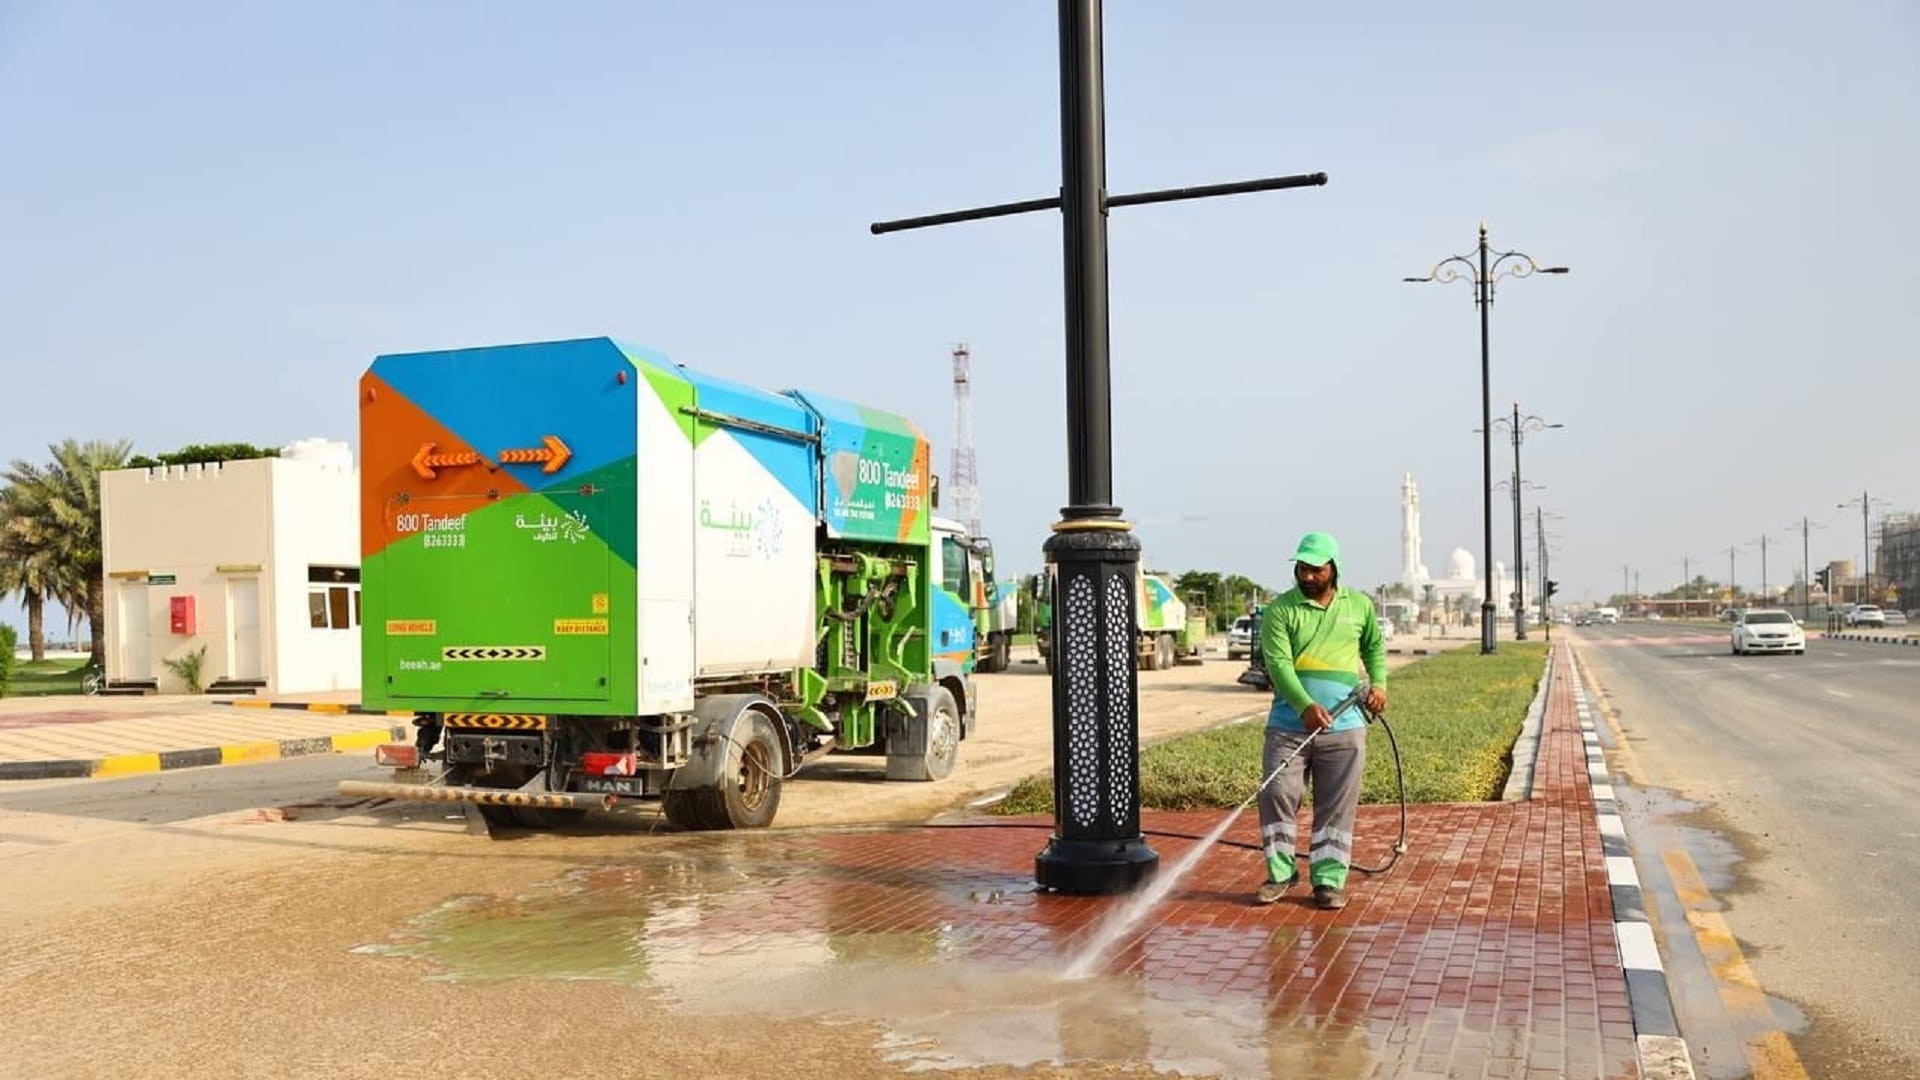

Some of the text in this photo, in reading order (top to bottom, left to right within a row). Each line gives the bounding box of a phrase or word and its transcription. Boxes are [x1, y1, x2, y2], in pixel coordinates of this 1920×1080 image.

[859, 458, 880, 485] 800
[396, 513, 467, 532] 800 Tandeef
[515, 513, 558, 532] بيئة
[587, 780, 631, 792] MAN
